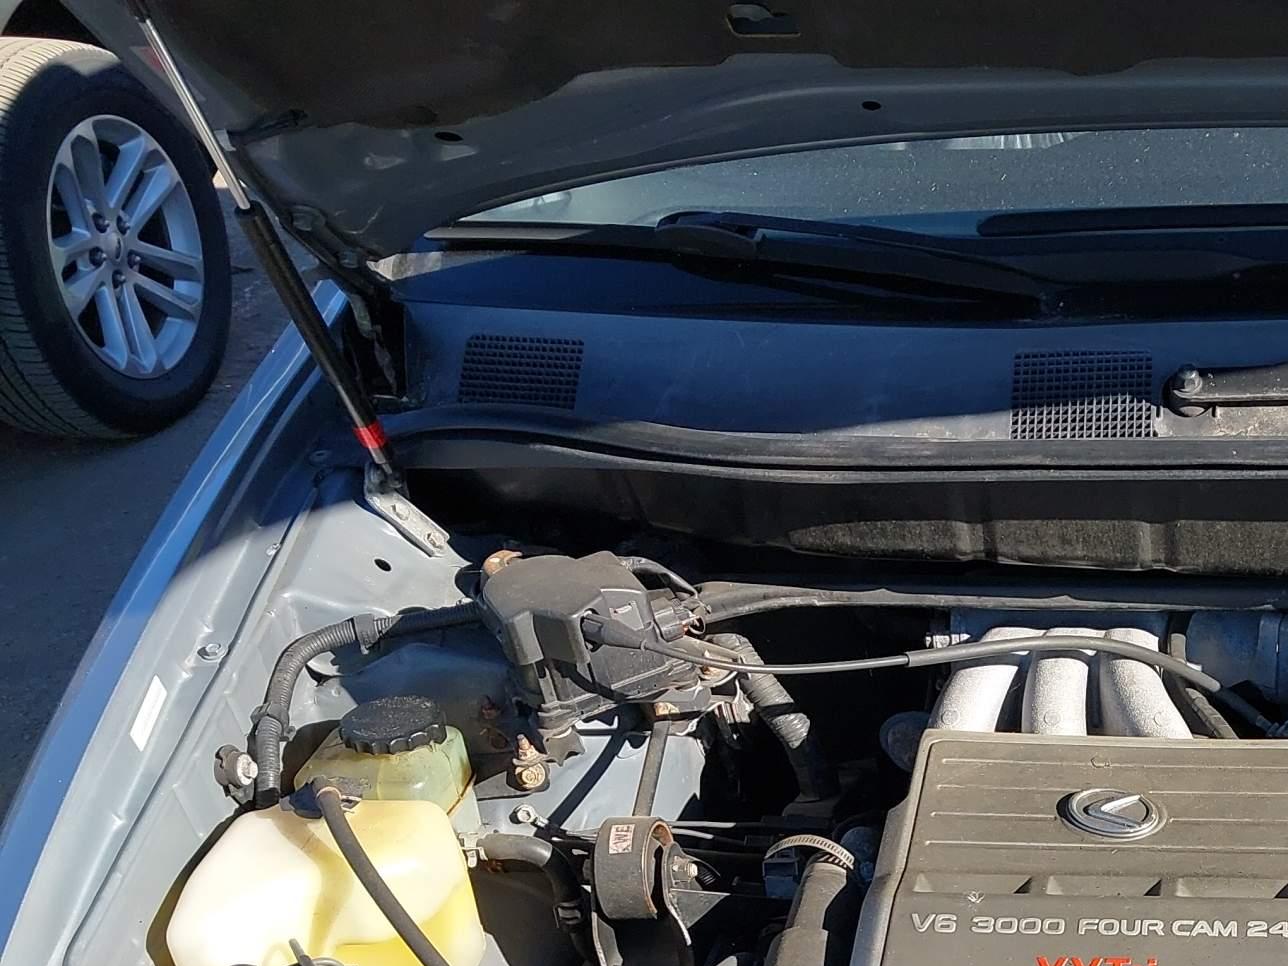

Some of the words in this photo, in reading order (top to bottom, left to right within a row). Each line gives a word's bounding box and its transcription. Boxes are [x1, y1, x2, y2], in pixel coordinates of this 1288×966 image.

[911, 912, 958, 933] V6
[970, 915, 1066, 935] 3000
[1077, 917, 1165, 936] FOUR
[1170, 919, 1238, 937] CAM
